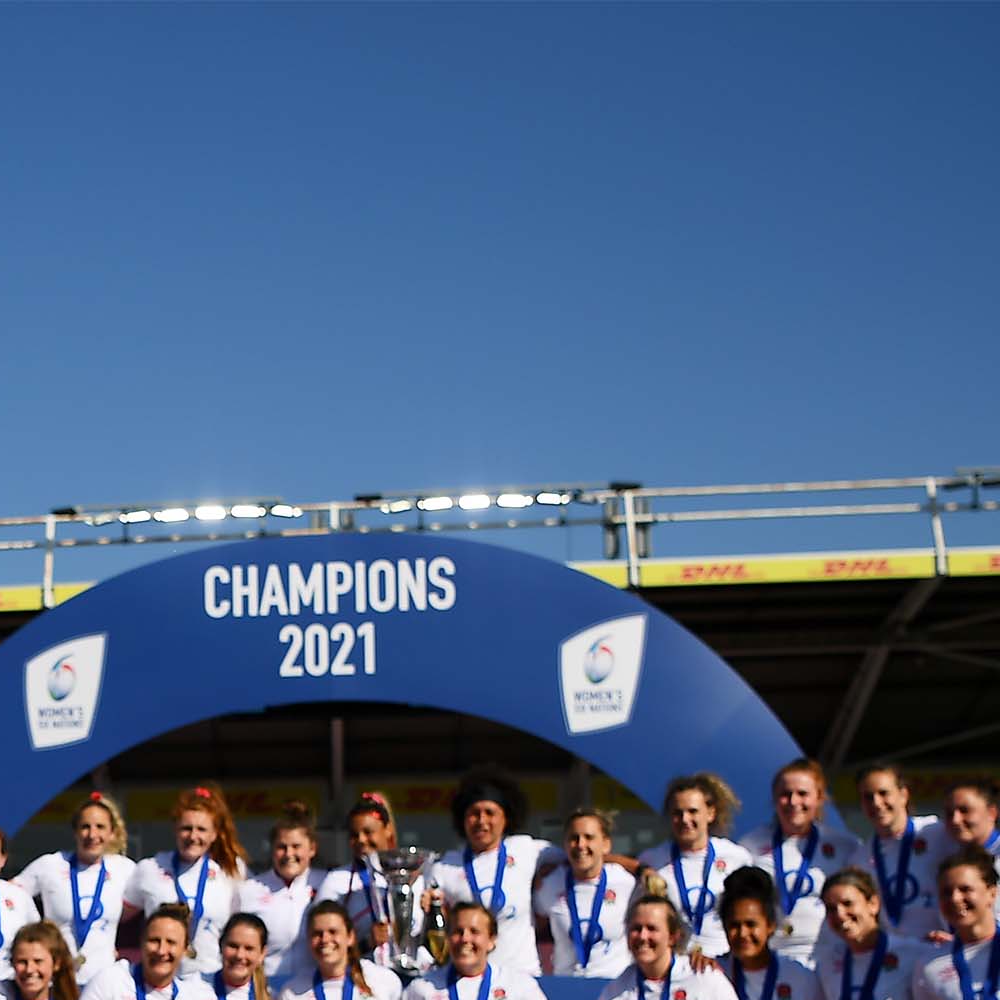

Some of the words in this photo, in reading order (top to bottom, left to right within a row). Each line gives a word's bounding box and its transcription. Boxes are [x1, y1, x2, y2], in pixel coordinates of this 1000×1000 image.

[203, 556, 457, 619] CHAMPIONS
[681, 563, 750, 581] DHL
[278, 621, 377, 678] 2021
